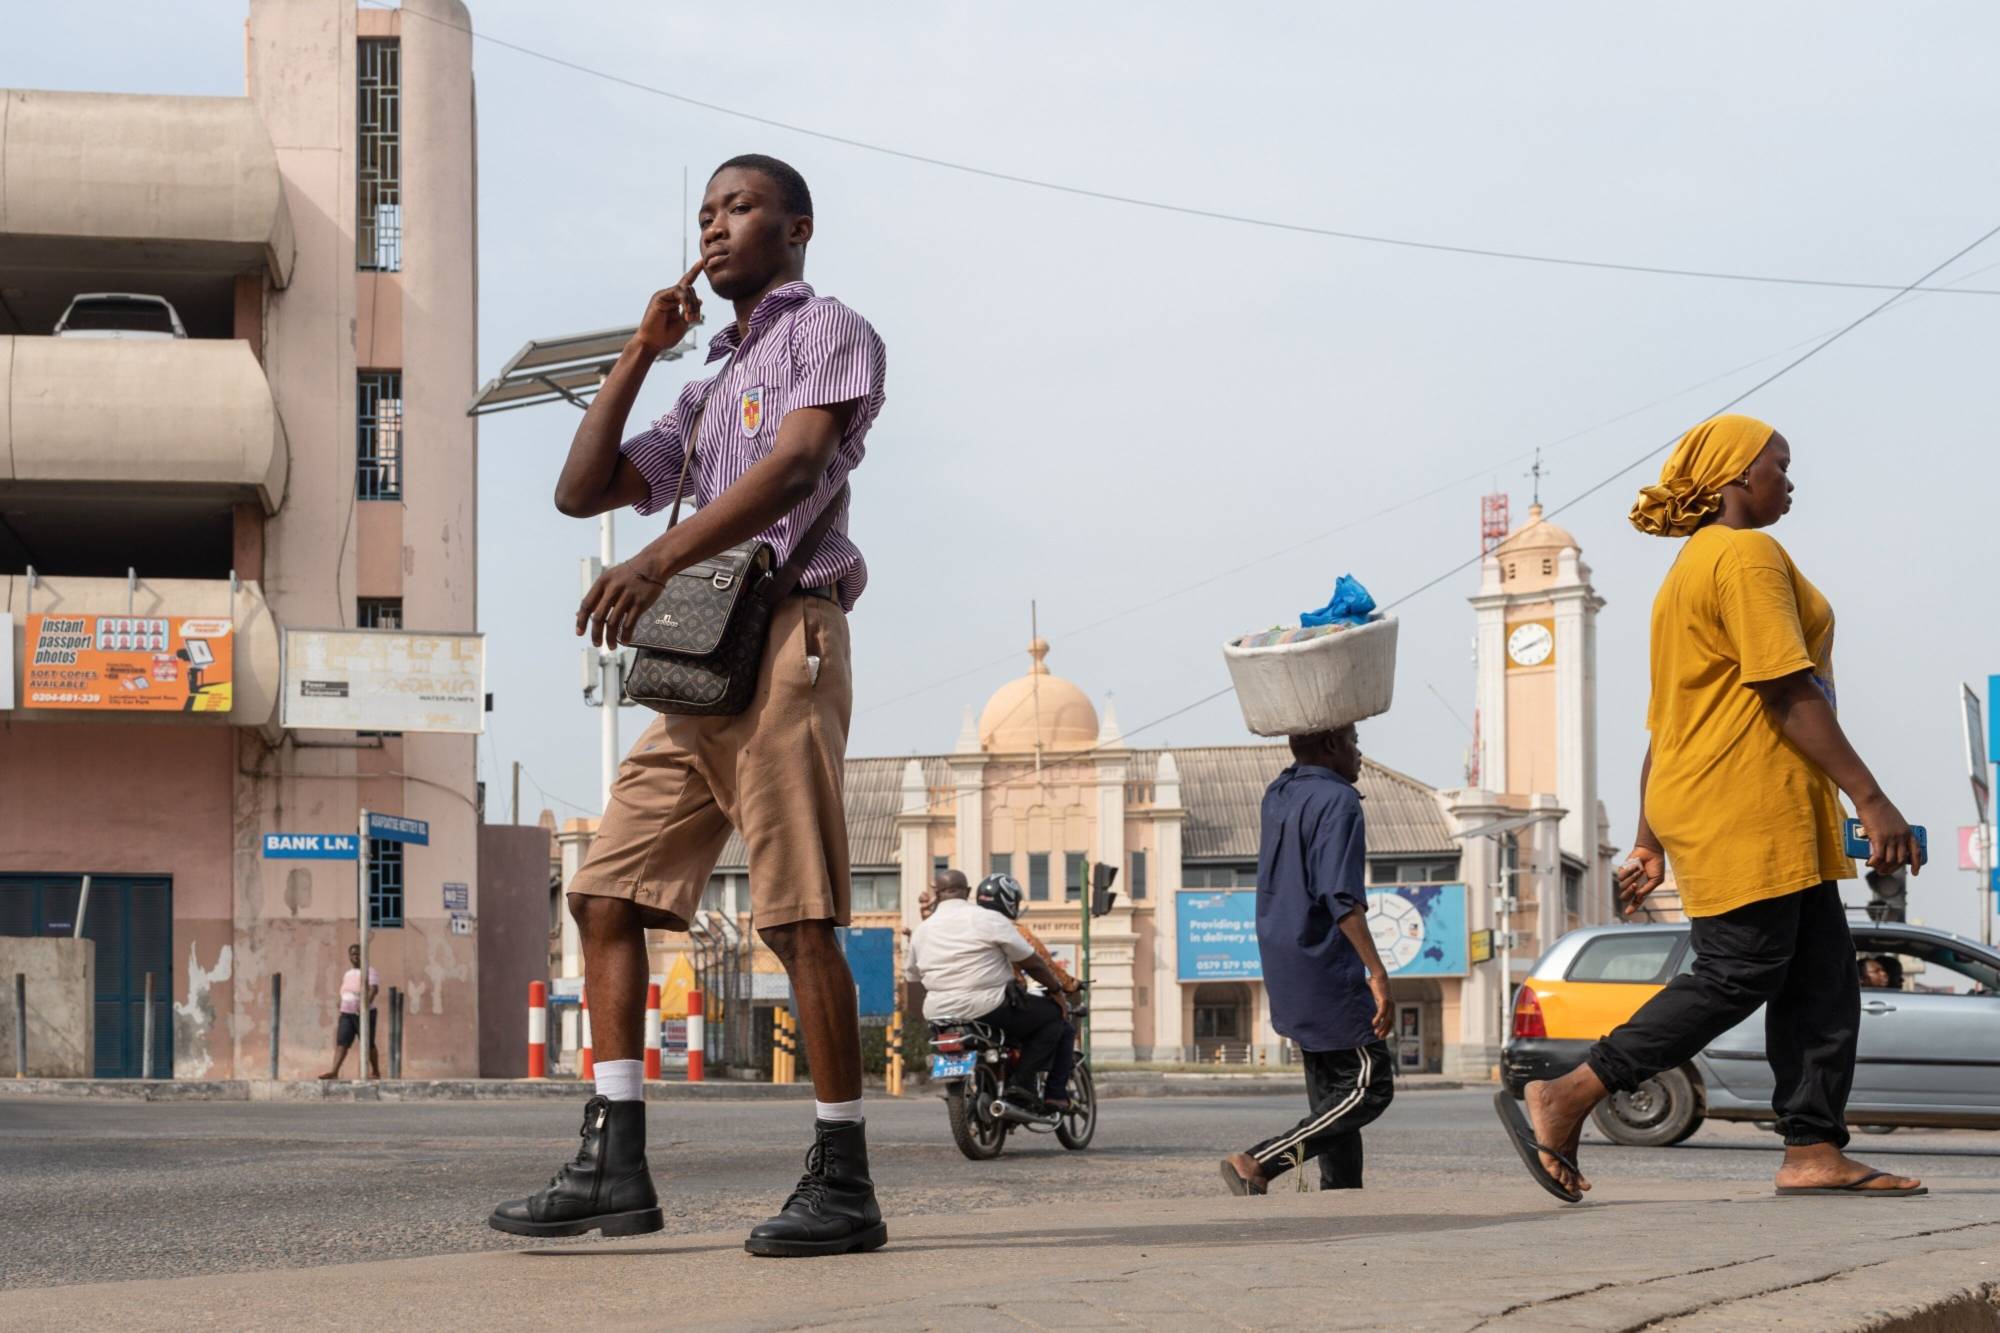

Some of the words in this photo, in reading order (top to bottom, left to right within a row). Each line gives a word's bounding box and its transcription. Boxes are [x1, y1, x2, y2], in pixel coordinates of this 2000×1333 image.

[42, 617, 84, 633] instant
[38, 635, 92, 649] passport
[35, 650, 76, 664] photos
[31, 670, 57, 678] SOFT
[60, 671, 97, 679] COPIES
[267, 836, 319, 850] BANK
[324, 837, 354, 850] LN.
[1190, 920, 1240, 930] Providing
[1190, 933, 1200, 942] in
[1203, 932, 1245, 944] delivery
[1196, 961, 1220, 970] 0579
[1222, 961, 1239, 969] 579
